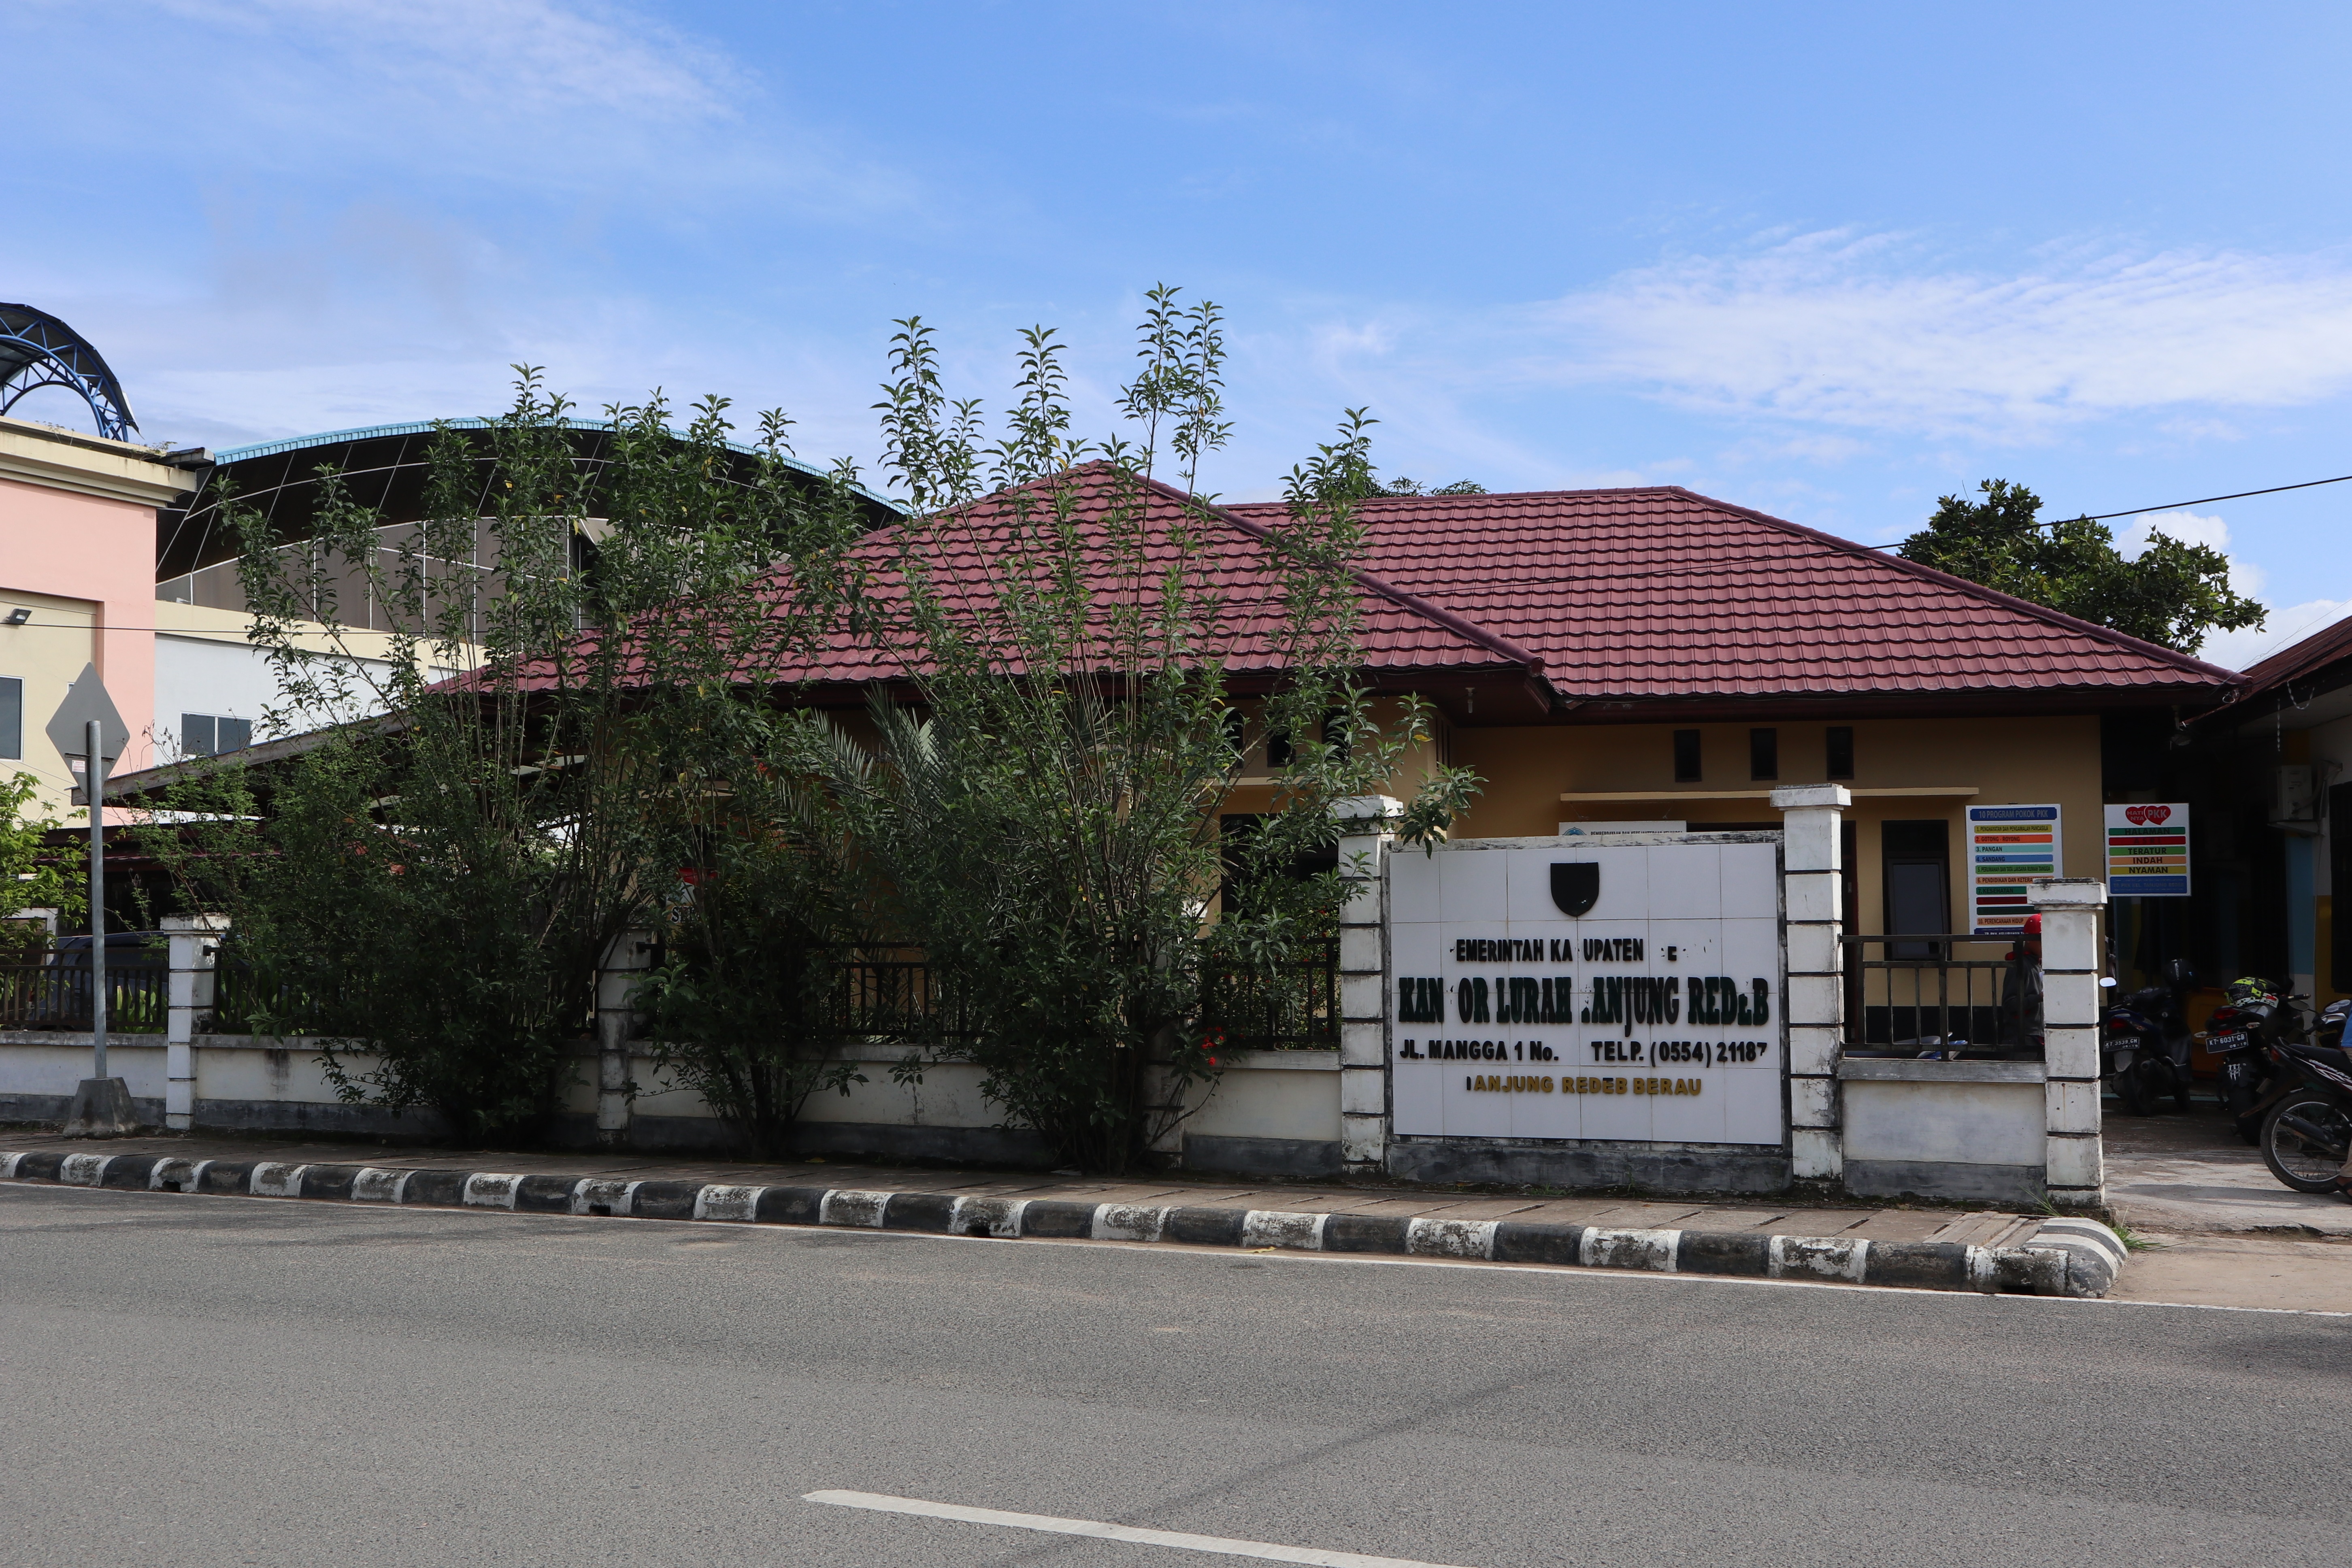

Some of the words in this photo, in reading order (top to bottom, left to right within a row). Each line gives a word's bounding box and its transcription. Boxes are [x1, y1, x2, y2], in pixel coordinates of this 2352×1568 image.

[1987, 810, 2014, 818] PROGRAM
[2016, 810, 2035, 818] POKOK
[2148, 809, 2167, 818] PKK
[1496, 977, 1572, 1023] LURAH
[1581, 976, 1679, 1037] ANJUNG
[1400, 1039, 1424, 1060] JL.
[1428, 1040, 1508, 1060] MANGGA
[1514, 1041, 1522, 1060] 1
[1530, 1041, 1559, 1061] No.
[1591, 1041, 1644, 1062] TELP.
[1650, 1041, 1712, 1068] (0554)
[1716, 1042, 1768, 1062] 21187
[1562, 1077, 1628, 1094] REDEB
[1633, 1078, 1702, 1095] BERAU
